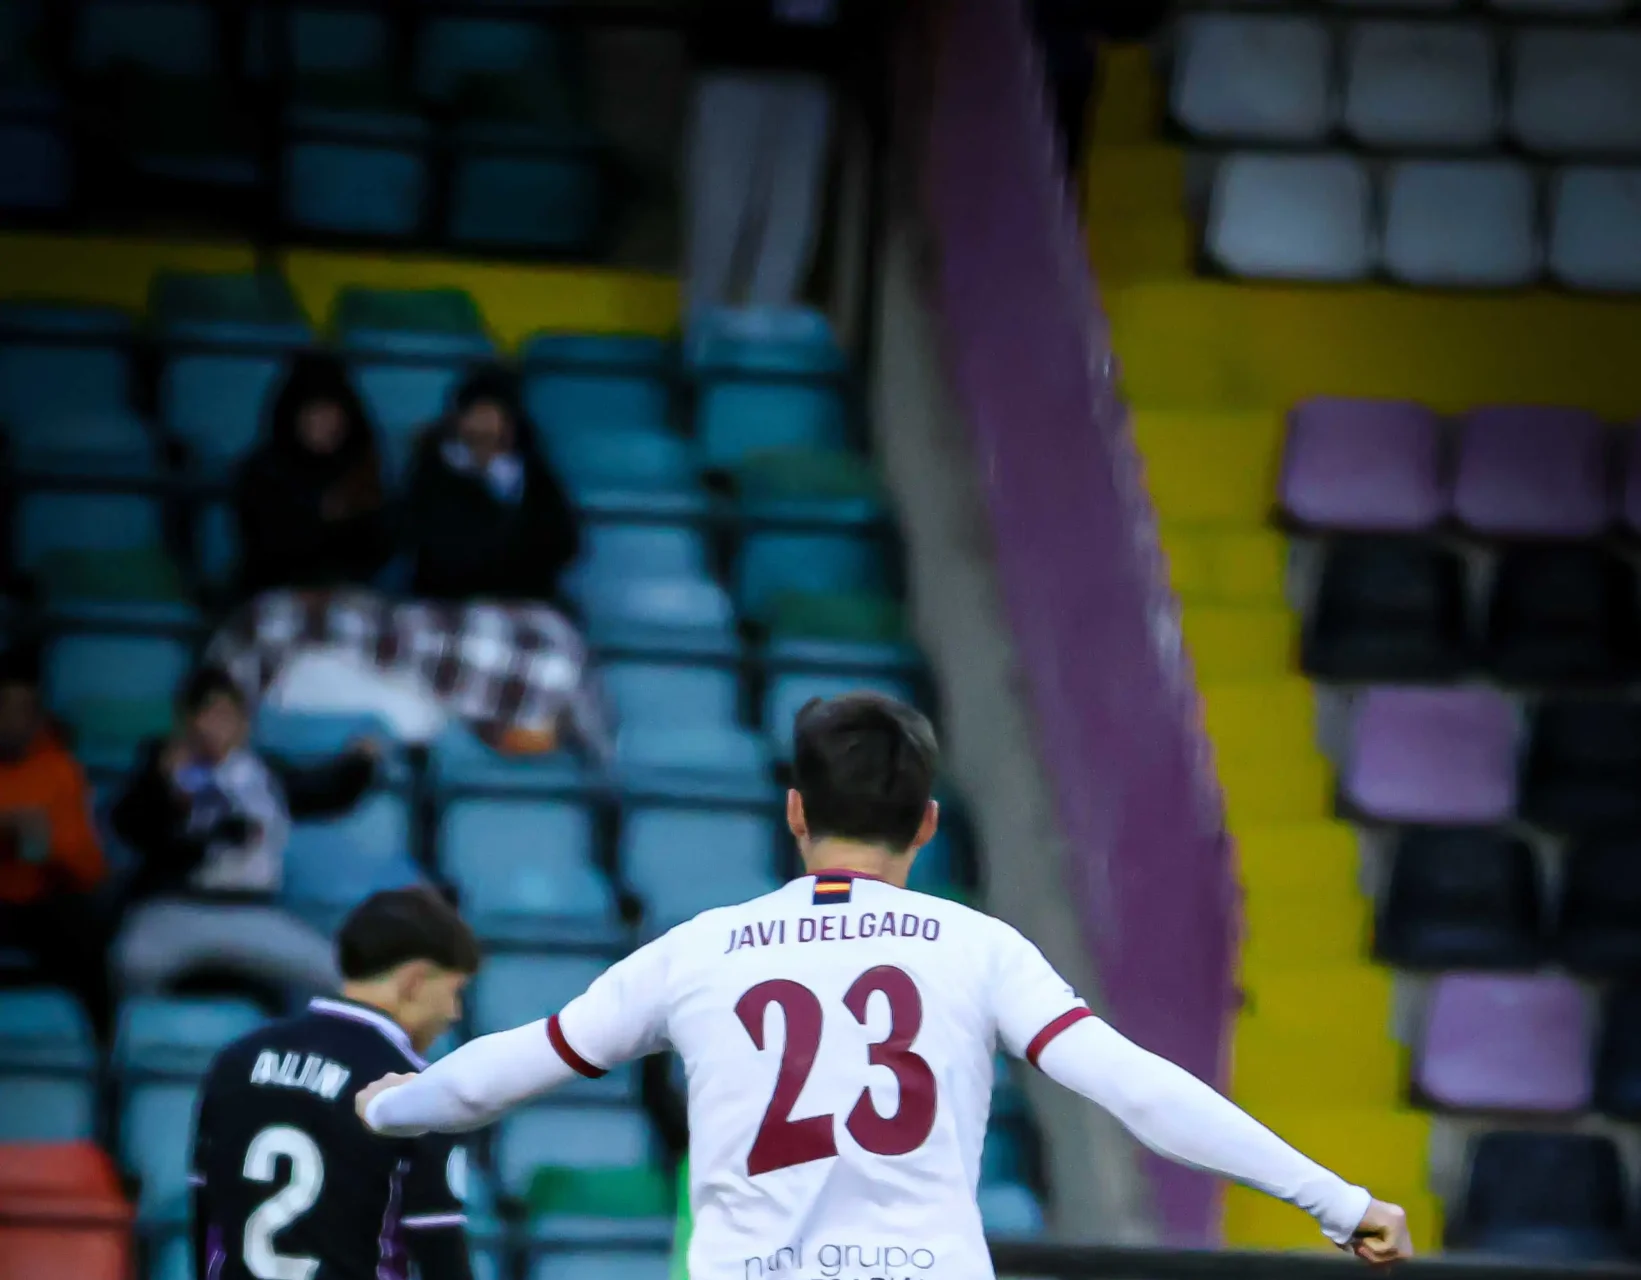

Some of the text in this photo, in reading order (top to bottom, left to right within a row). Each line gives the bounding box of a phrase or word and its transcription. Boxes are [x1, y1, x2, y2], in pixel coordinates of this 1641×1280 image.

[723, 911, 940, 954] JAVI DELGADO
[734, 965, 938, 1177] 23
[818, 1244, 935, 1277] grupo
